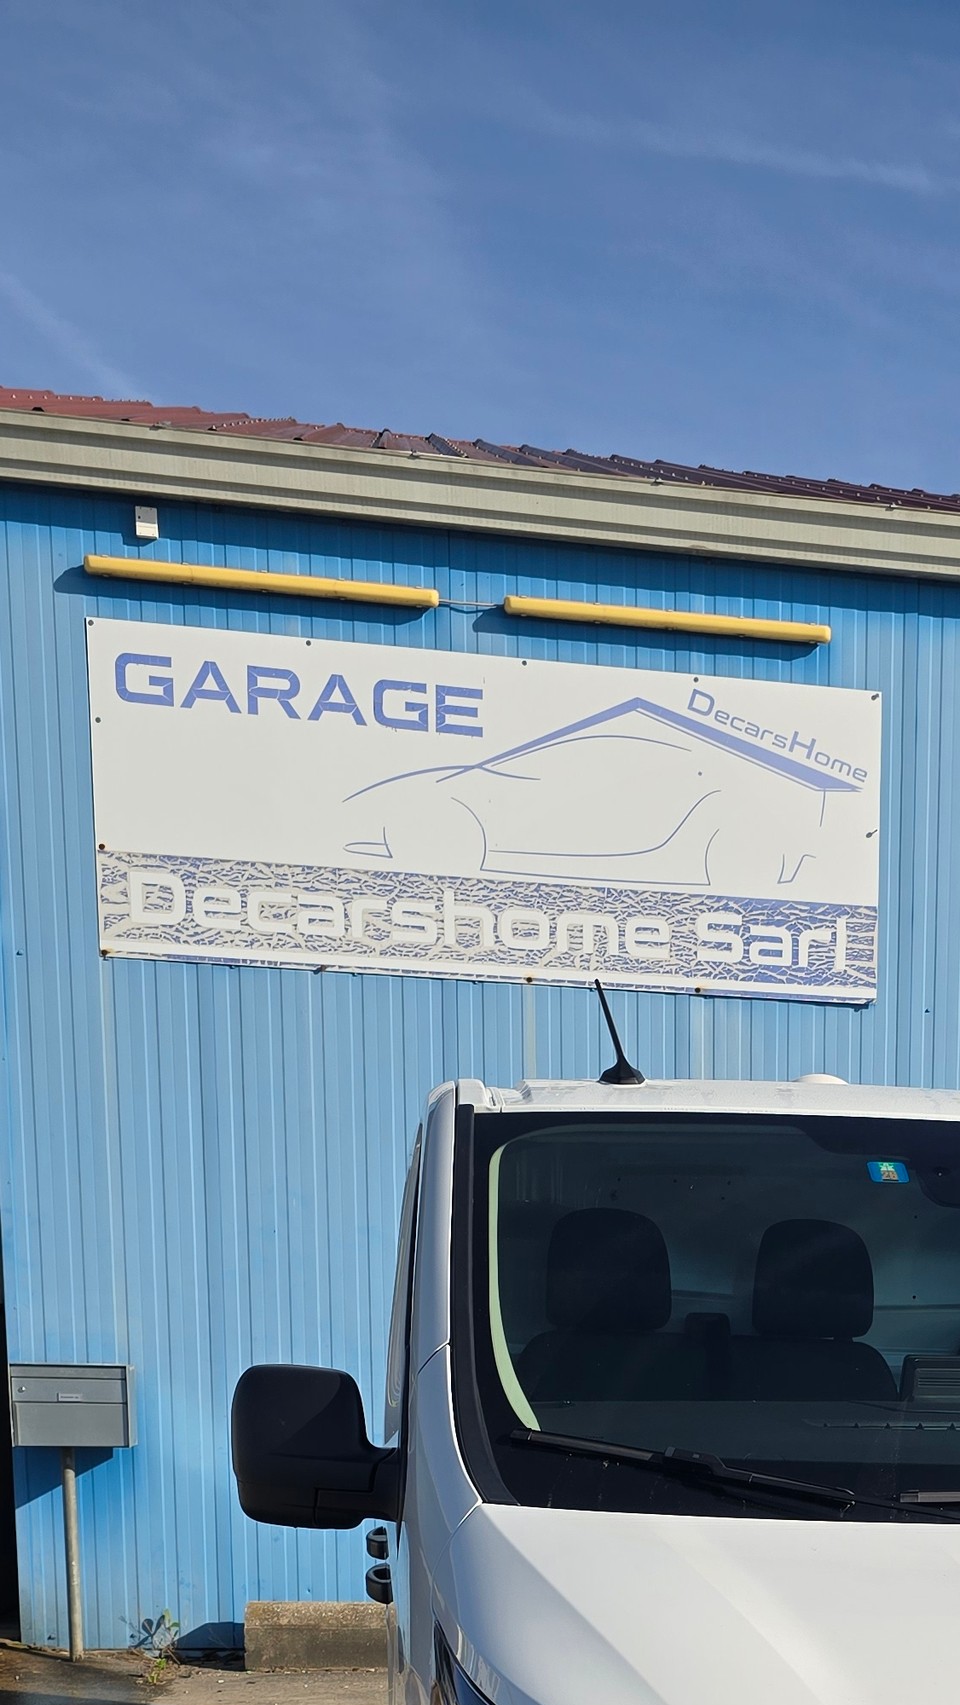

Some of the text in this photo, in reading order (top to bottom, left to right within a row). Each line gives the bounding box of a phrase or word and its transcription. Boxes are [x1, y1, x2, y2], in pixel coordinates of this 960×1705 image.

[115, 652, 484, 738] GARAGE
[687, 688, 868, 783] DecarsHome
[128, 869, 847, 970] Decarshome Sarl
